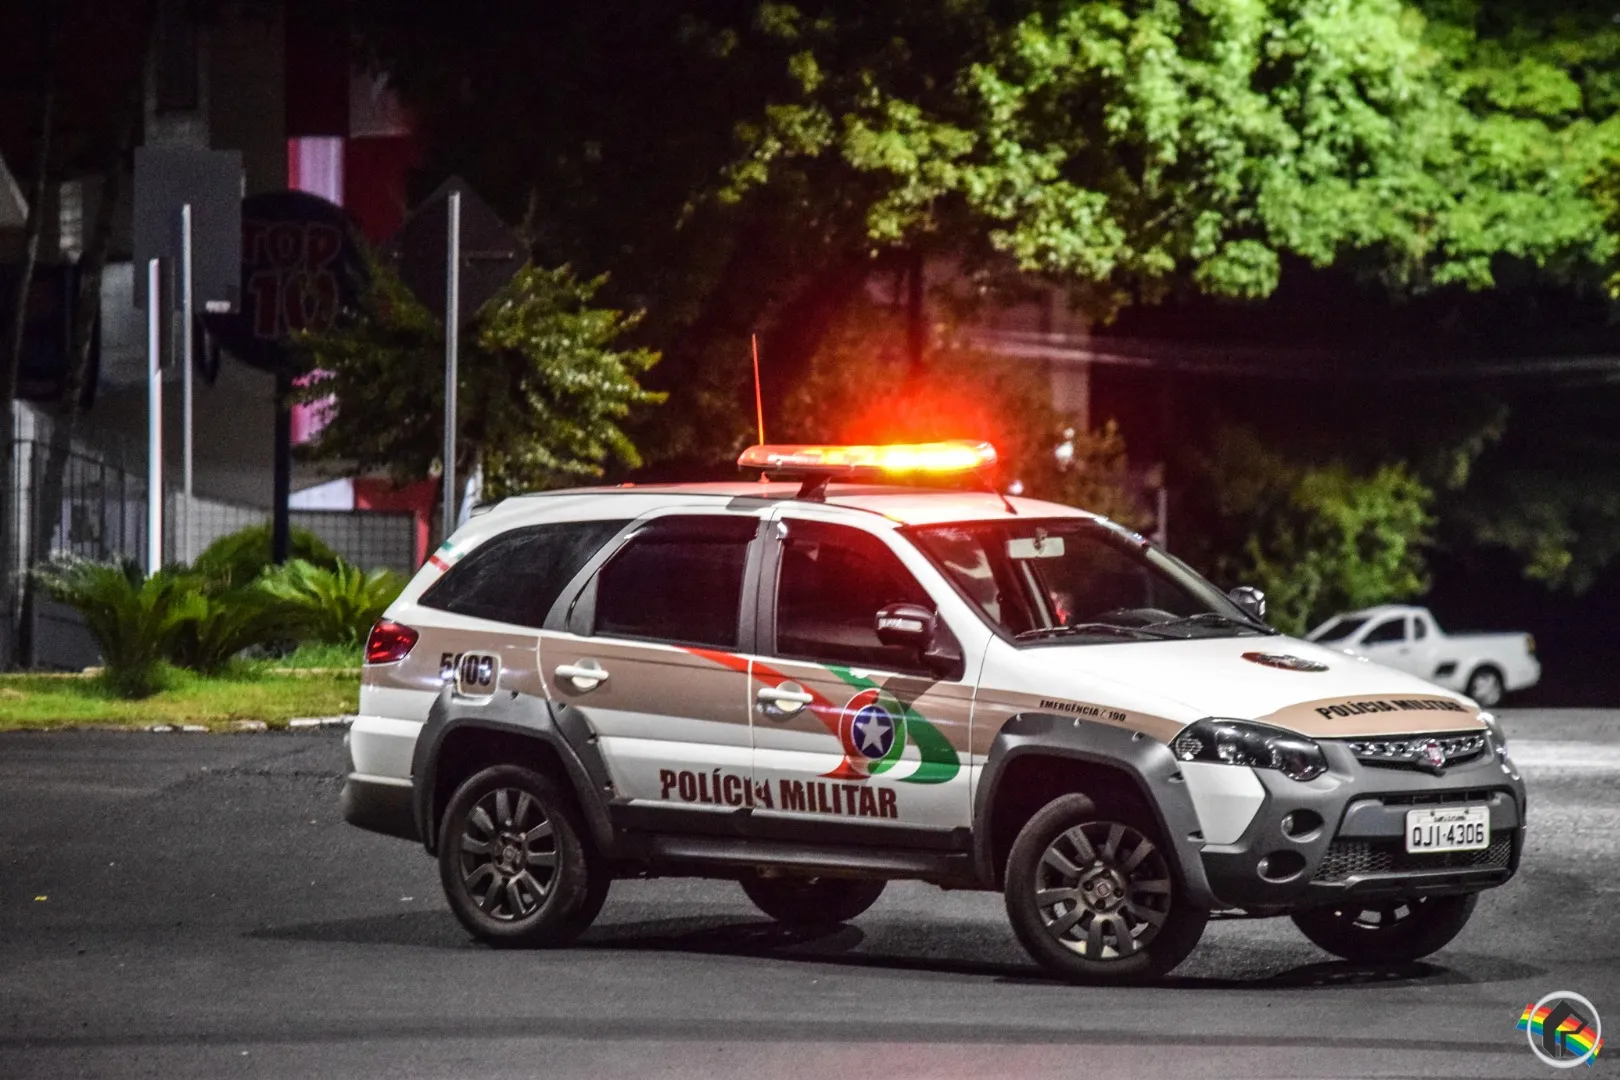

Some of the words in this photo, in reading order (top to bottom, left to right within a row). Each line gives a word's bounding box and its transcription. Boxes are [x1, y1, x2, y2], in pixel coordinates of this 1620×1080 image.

[247, 270, 340, 338] 10
[1040, 699, 1099, 717] EMERGÊNCIA
[1109, 710, 1126, 721] 190
[1314, 700, 1398, 720] POLÍCIA
[1391, 700, 1469, 713] MILITAR
[660, 767, 774, 809] POLÍCIA
[779, 779, 899, 818] MILITAR
